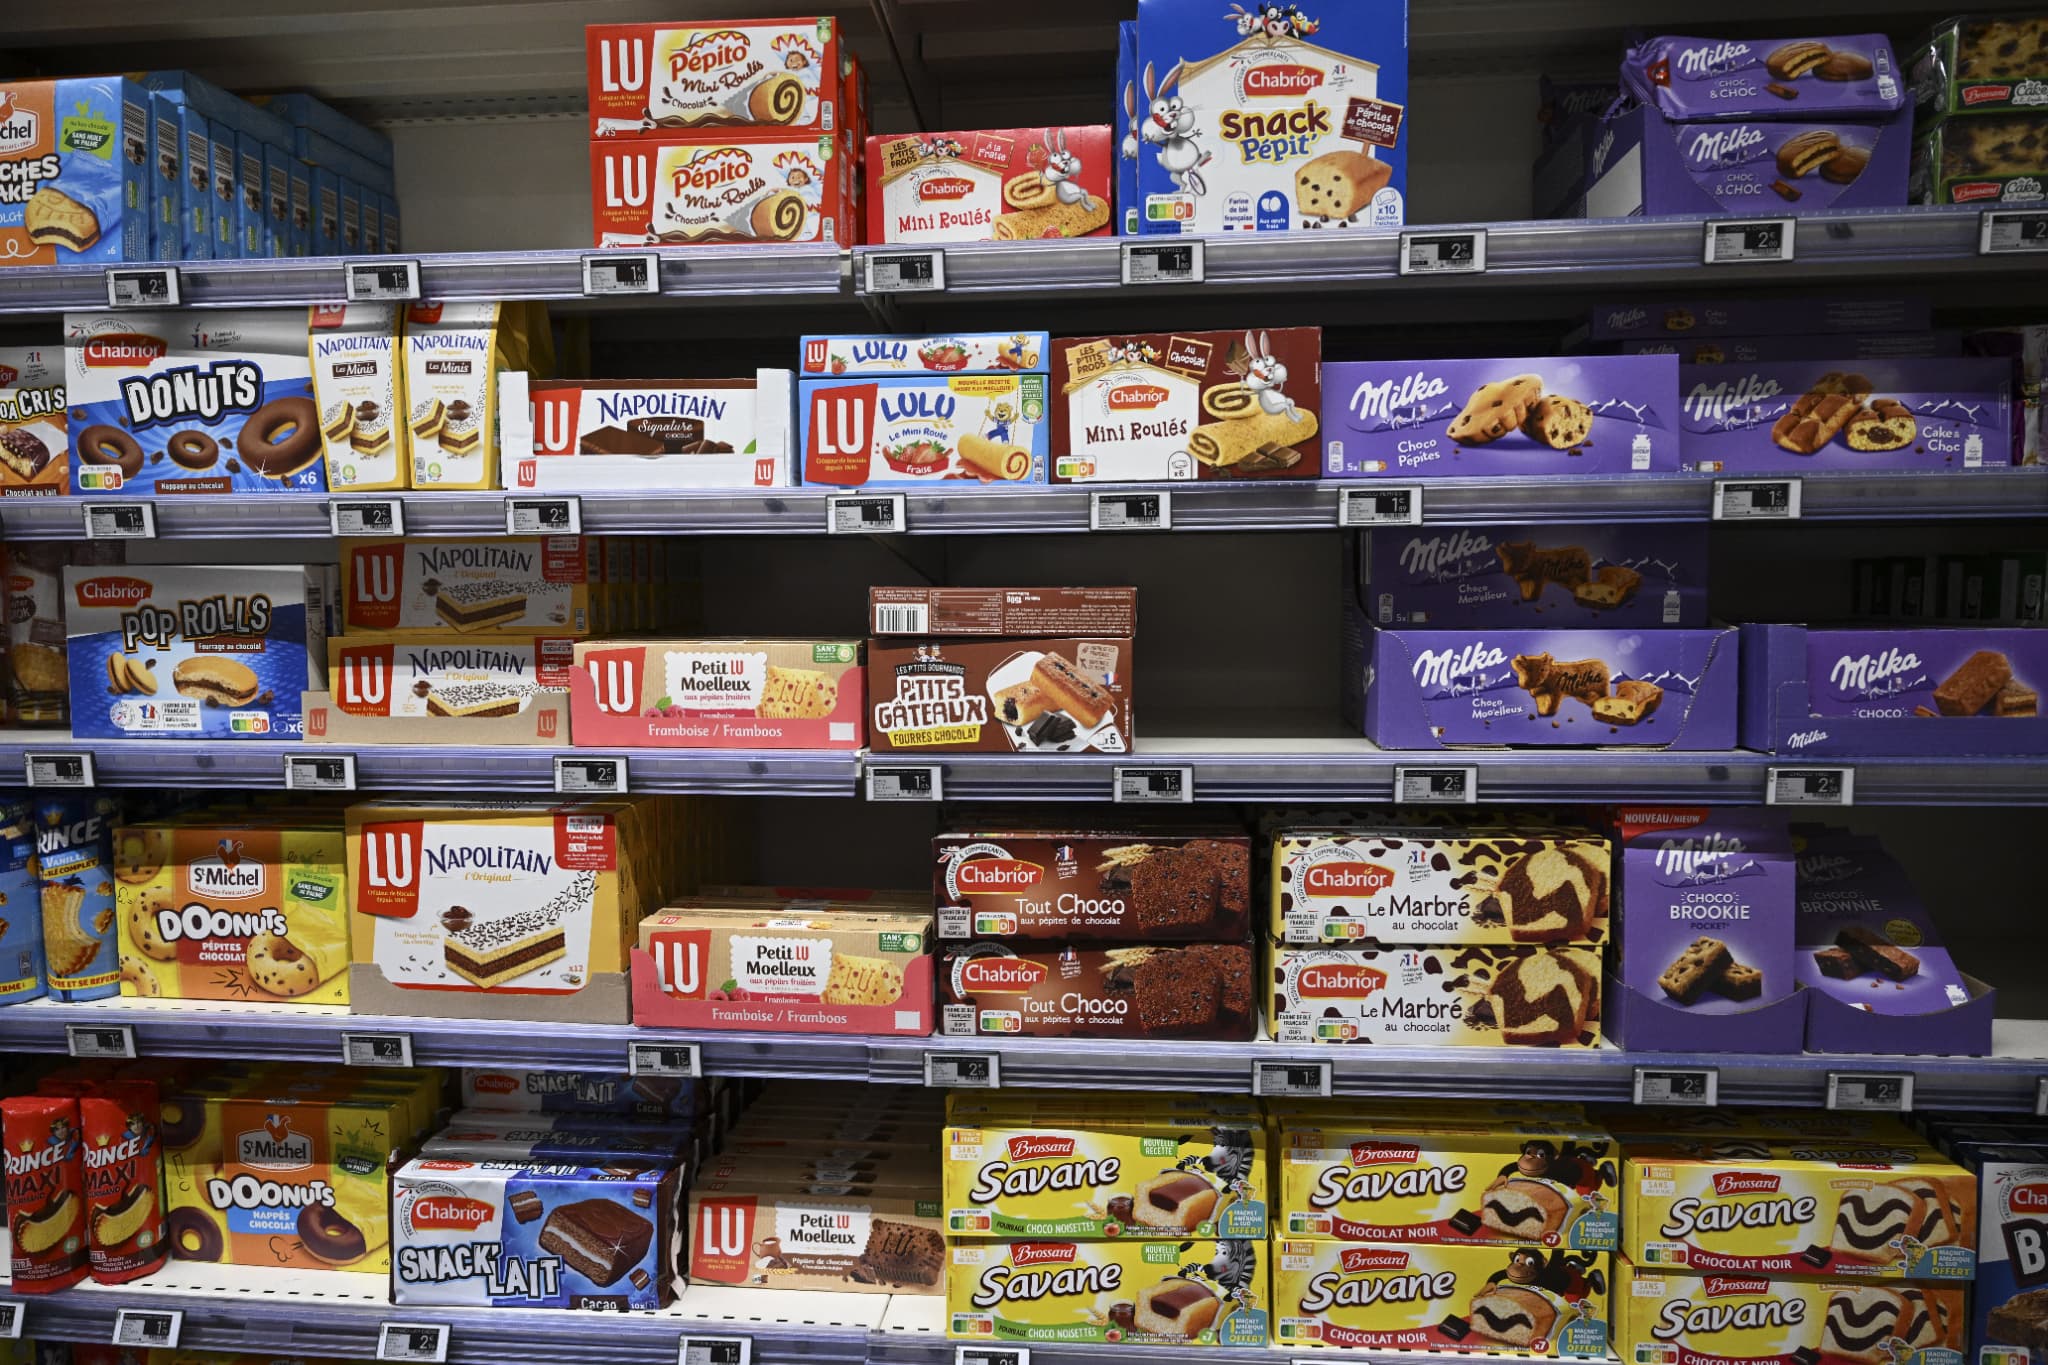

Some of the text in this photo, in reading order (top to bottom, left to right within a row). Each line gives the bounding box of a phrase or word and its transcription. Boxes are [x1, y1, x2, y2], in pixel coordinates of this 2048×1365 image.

[601, 39, 644, 92] LU
[669, 45, 747, 82] Pépito
[1677, 42, 1751, 74] Milka
[682, 60, 764, 93] Mini Roulés
[1248, 70, 1319, 88] Chabrior
[1719, 79, 1746, 87] CHOC
[1720, 87, 1757, 98] CHOC
[671, 98, 707, 110] Chocolat
[1222, 103, 1328, 139] Snack
[893, 141, 907, 151] LES
[1240, 134, 1317, 162] Pépit'
[1689, 125, 1765, 162] Milka
[891, 156, 917, 169] PRODS
[605, 155, 647, 207] LU
[672, 162, 749, 197] Pépito
[922, 180, 971, 195] Chabrior
[685, 178, 765, 209] Mini Roulés
[1725, 184, 1761, 194] CHOC
[675, 214, 710, 225] Chocolat
[899, 208, 991, 233] Mini Roulés
[89, 341, 159, 359] Chabrior
[316, 336, 390, 358] NAPOLITAIN
[412, 335, 486, 353] NAPOLITAIN
[853, 341, 907, 363] LULU
[1079, 346, 1095, 356] LES
[808, 344, 824, 363] LU
[347, 364, 374, 374] Minis
[441, 363, 469, 373] Minis
[1077, 360, 1106, 375] PRODS
[125, 367, 257, 424] DONUTS
[1111, 390, 1164, 404] Chabrior
[1350, 371, 1448, 420] Milka
[1684, 373, 1784, 420] Milka
[597, 393, 726, 424] NAPOLITAIN
[881, 392, 955, 422] LULU
[637, 419, 693, 437] Signature
[817, 398, 864, 454] LU
[1085, 418, 1187, 444] Mini Roulés
[1398, 439, 1437, 453] Choco
[1928, 439, 1961, 453] Choc
[1398, 450, 1441, 467] Pépites
[198, 482, 224, 490] chocolat
[299, 473, 317, 485] x6
[1401, 529, 1493, 573] Milka
[418, 547, 533, 576] NAPOLITAIN
[356, 554, 395, 602] LU
[82, 583, 146, 600] Chabrior
[125, 596, 268, 648] POP ROLLS
[236, 642, 262, 650] chocolat
[408, 649, 525, 677] NAPOLITAIN
[691, 660, 744, 676] Petit LU
[1414, 641, 1508, 687] Milka
[1830, 648, 1921, 691] Milka
[345, 656, 384, 704] LU
[680, 676, 751, 692] Moelleux
[878, 700, 985, 730] GÂTEAUX
[1858, 709, 1902, 718] CHOCO
[648, 724, 709, 736] Framboise
[723, 724, 782, 738] Framboos
[1788, 730, 1829, 748] Milka
[367, 832, 413, 887] LU
[424, 844, 552, 876] NAPOLITAIN
[1656, 832, 1746, 875] Milka
[960, 865, 1036, 884] Chabrior
[1309, 868, 1387, 887] Chabrior
[1015, 894, 1125, 915] Tout Choco
[1368, 895, 1471, 917] Le Marbré
[1686, 894, 1734, 903] CHOCO
[1802, 900, 1883, 913] BROWNIE
[159, 904, 287, 940] DOONUTS
[1020, 916, 1121, 926] aux pépites de chocolat
[1670, 906, 1751, 920] BROOKIE
[1392, 920, 1459, 930] au chocolat
[202, 940, 242, 952] PÉPITES
[757, 945, 809, 960] Petit LU
[199, 952, 246, 961] CHOCOLAT
[655, 941, 699, 993] LU
[746, 961, 816, 977] Moelleux
[965, 964, 1041, 983] Chabrior
[1302, 970, 1380, 989] Chabrior
[1019, 993, 1128, 1014] Tout Choco
[1361, 997, 1462, 1019] Le Marbré
[712, 1008, 774, 1022] Framboise
[787, 1011, 847, 1024] Framboos
[1025, 1016, 1124, 1025] aux pépites de chocolat
[1385, 1022, 1451, 1032] au chocolat
[1013, 1140, 1072, 1157] Brossard
[1354, 1147, 1416, 1164] Brossard
[970, 1157, 1120, 1202] Savane
[1311, 1166, 1467, 1206] Savane
[1716, 1176, 1776, 1192] Brossard
[209, 1176, 335, 1208] DOONUTS
[416, 1203, 488, 1220] Chabrior
[1661, 1196, 1816, 1238] Savane
[249, 1219, 296, 1230] CHOCOLAT
[800, 1214, 849, 1228] Petit LU
[1027, 1222, 1052, 1233] CHOCO
[1056, 1222, 1095, 1233] NOISETTES
[703, 1206, 744, 1256] LU
[790, 1229, 855, 1244] Moelleux
[1339, 1224, 1438, 1238] CHOCOLAT NOIR
[1546, 1235, 1557, 1244] x7
[1015, 1246, 1074, 1262] Brossard
[1346, 1253, 1406, 1270] Brossard
[1694, 1253, 1793, 1269] CHOCOLAT NOIR
[488, 1257, 565, 1299] LAIT
[973, 1264, 1122, 1307] Savane
[1707, 1278, 1767, 1294] Brossard
[1301, 1271, 1456, 1312] Savane
[581, 1297, 617, 1310] Cacao
[1653, 1299, 1806, 1338] Savane
[1028, 1327, 1097, 1338] CHOCO NOISETTES
[1330, 1329, 1428, 1344] CHOCOLAT NOIR
[1535, 1341, 1546, 1349] x7
